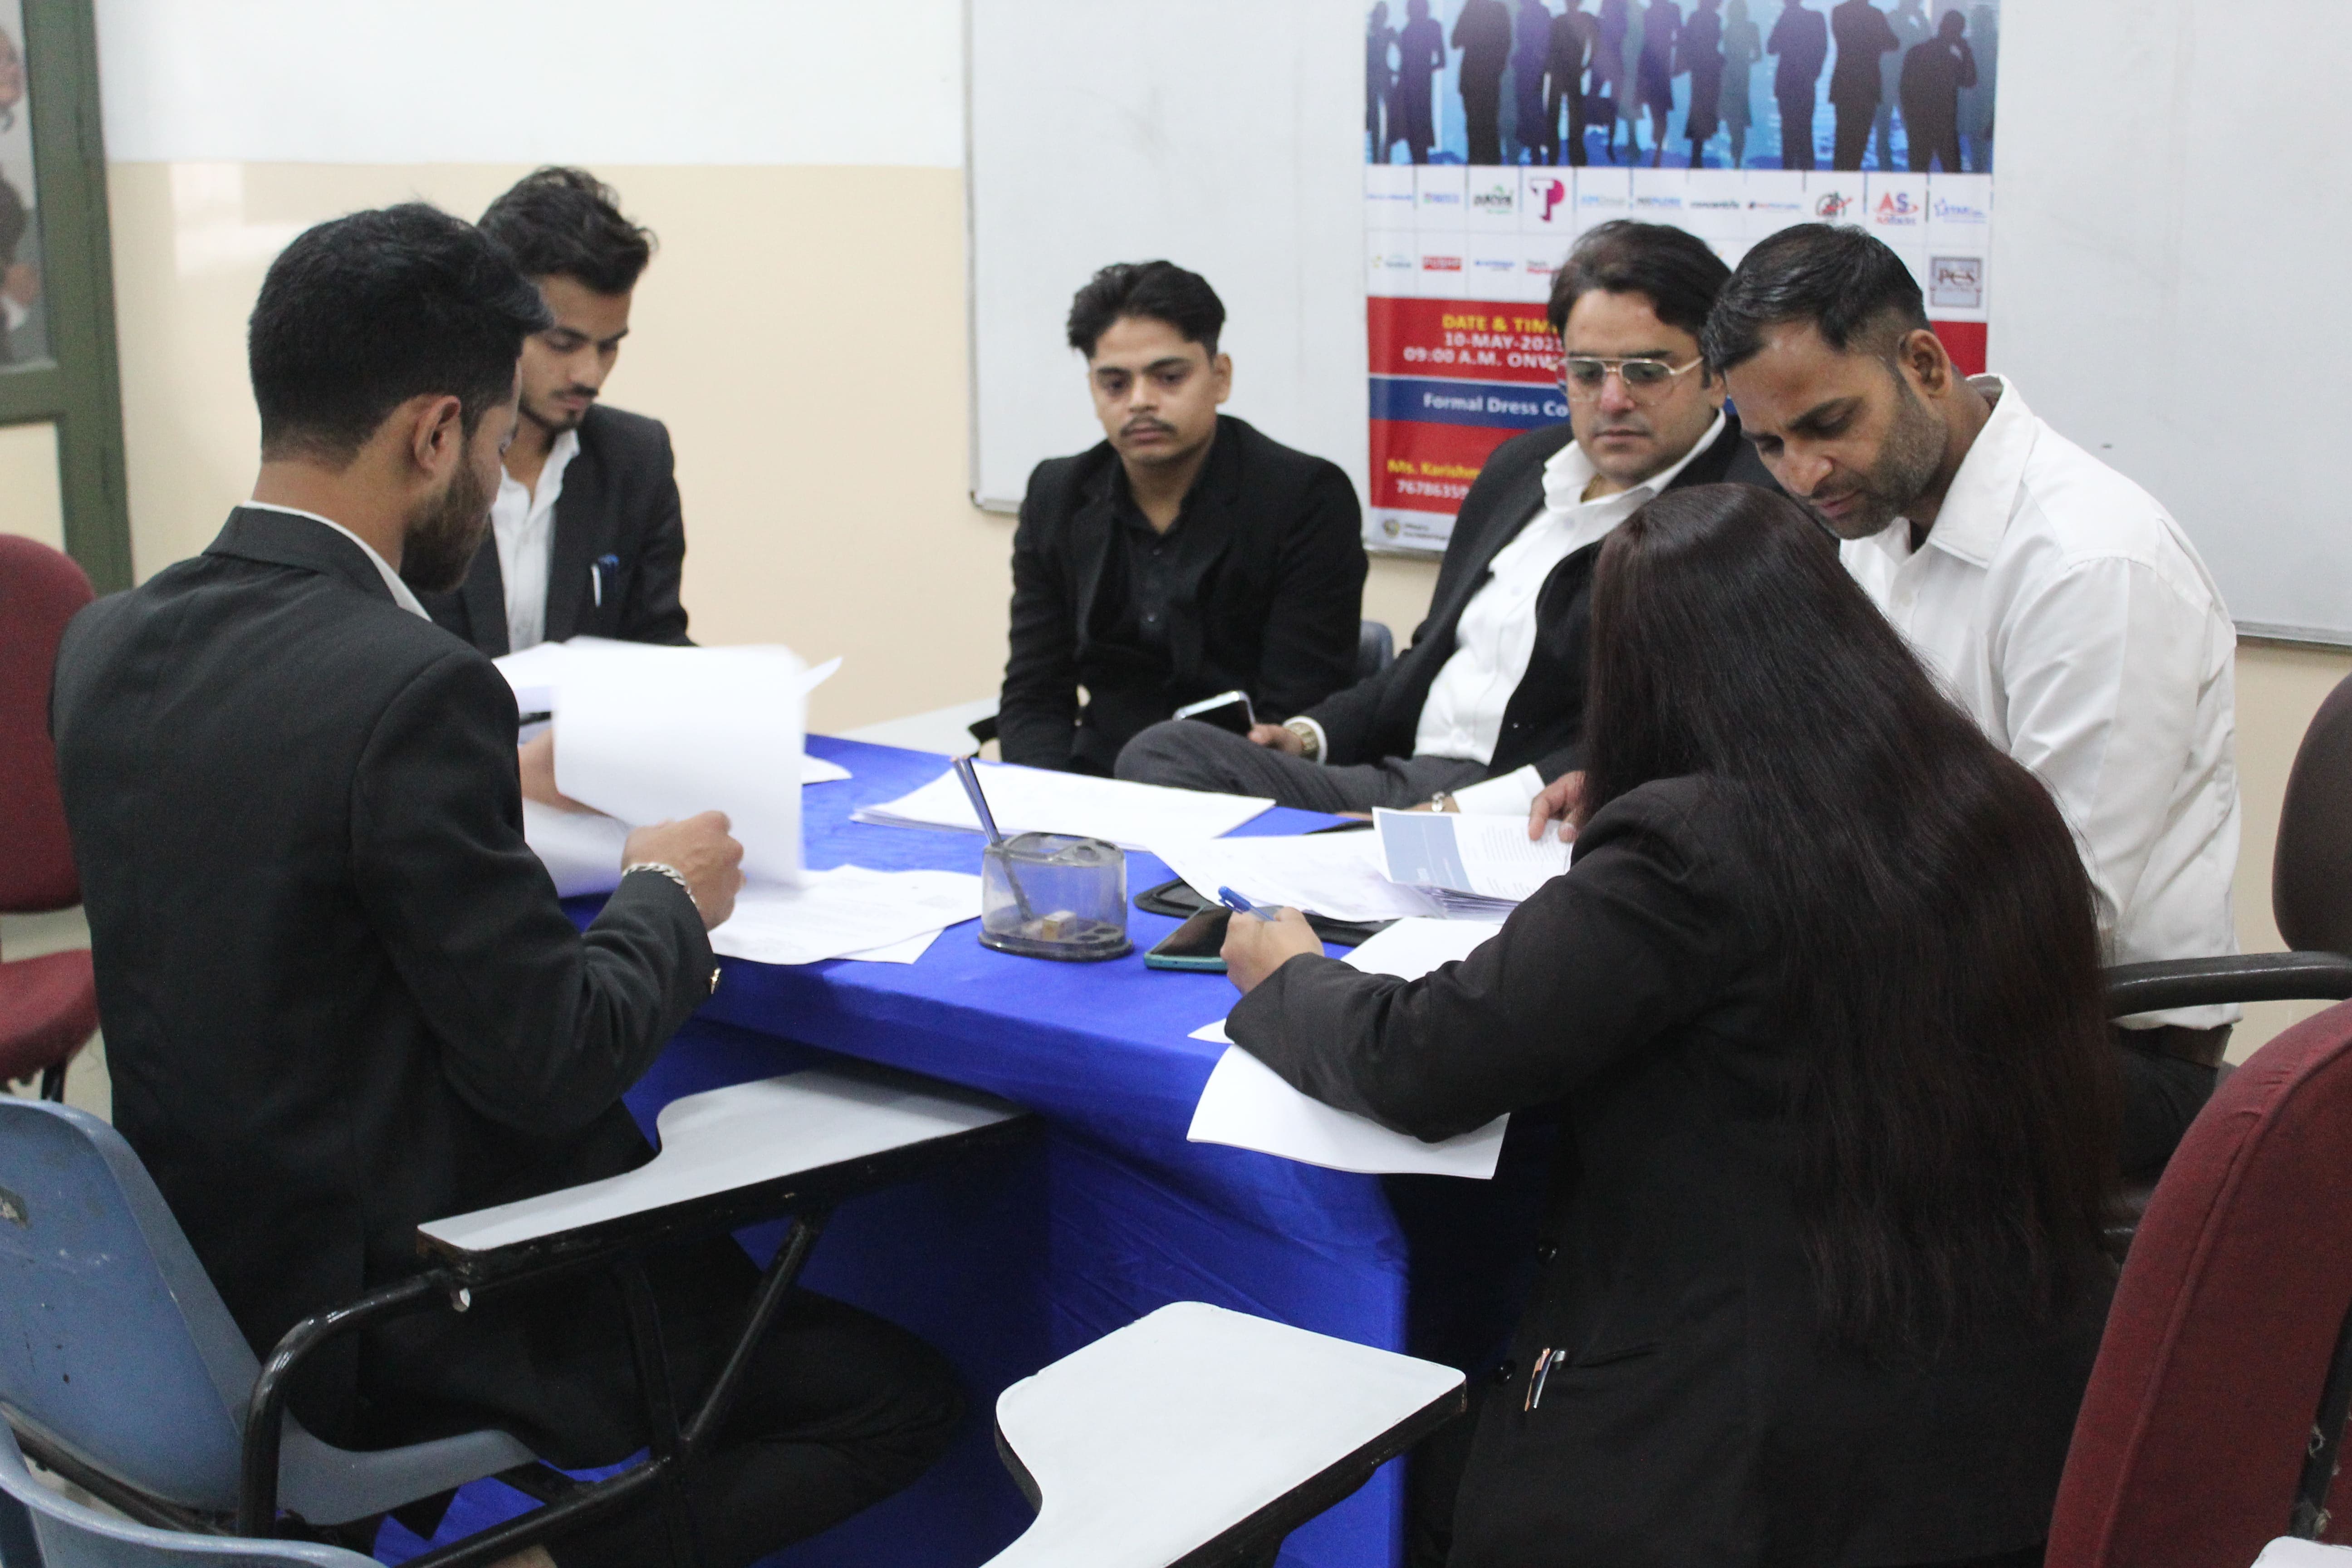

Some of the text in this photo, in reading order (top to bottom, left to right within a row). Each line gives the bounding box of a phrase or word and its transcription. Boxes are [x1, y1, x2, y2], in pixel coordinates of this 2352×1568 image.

[1878, 193, 1908, 213] AS
[1442, 315, 1558, 334] DATE & TIM
[1403, 346, 1455, 363] 09:00
[1458, 349, 1502, 367] A.M.
[1423, 392, 1483, 412] Formal
[1487, 396, 1539, 415] Dress
